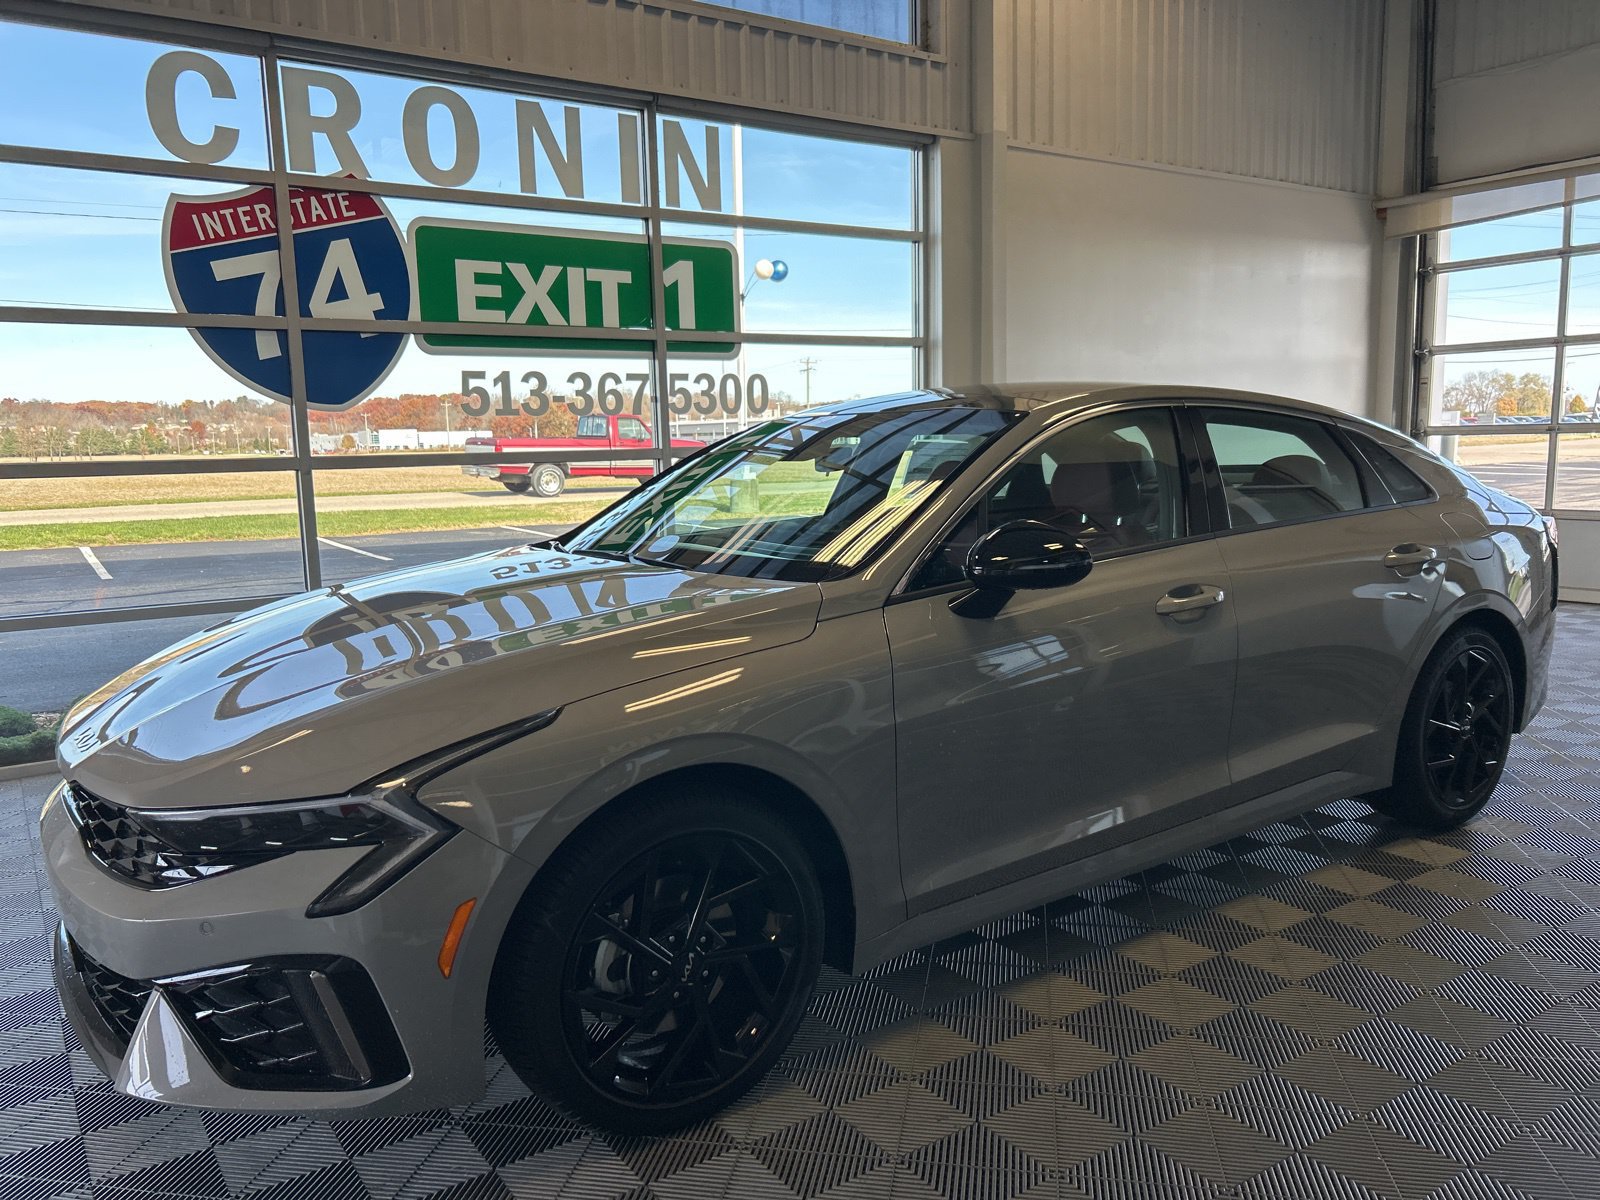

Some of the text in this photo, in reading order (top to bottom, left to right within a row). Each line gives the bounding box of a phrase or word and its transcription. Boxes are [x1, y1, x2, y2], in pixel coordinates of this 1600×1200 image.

[145, 50, 722, 212] CRONIN
[191, 192, 356, 241] INTERTATE
[210, 238, 384, 360] 74
[454, 258, 696, 329] EXIT 1
